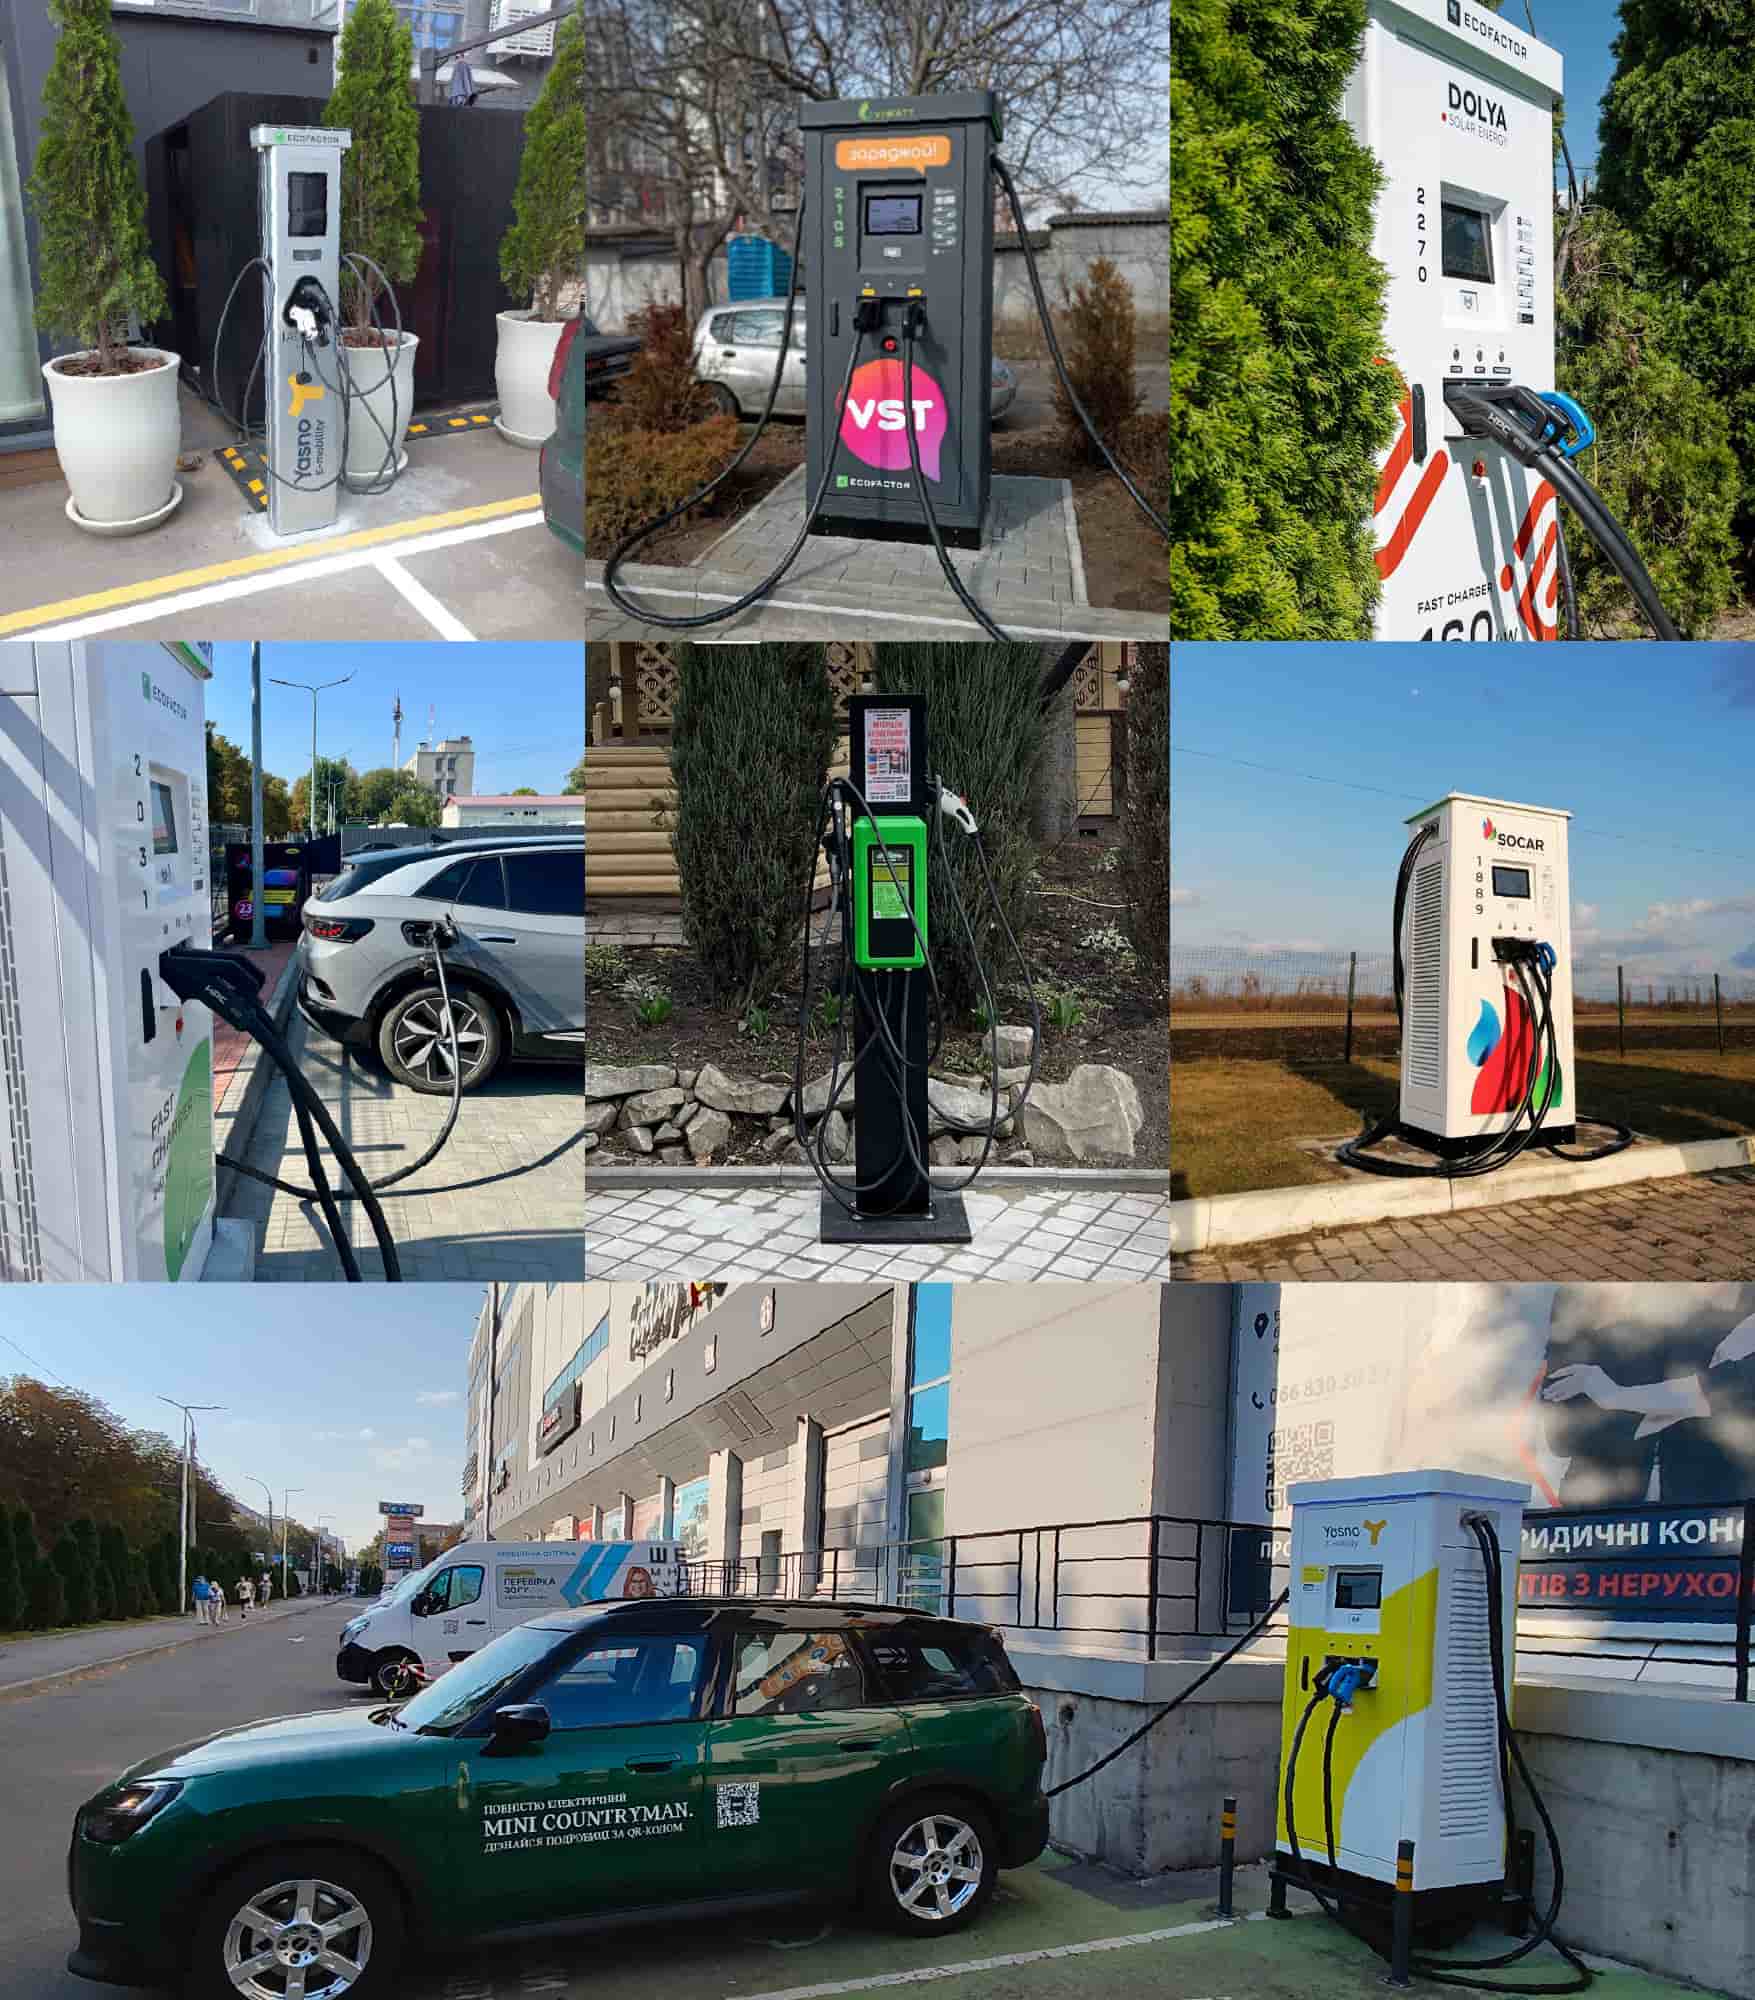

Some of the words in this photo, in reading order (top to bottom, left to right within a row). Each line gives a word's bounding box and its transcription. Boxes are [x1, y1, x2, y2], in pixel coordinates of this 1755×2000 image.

[1463, 12, 1528, 61] ECOFACTOR
[1448, 80, 1508, 132] DOLYA
[1448, 114, 1476, 134] SOLAR
[845, 398, 935, 432] VST
[294, 418, 313, 485] Yasno
[849, 478, 911, 489] ECOFACTOR
[1416, 595, 1444, 615] FAST
[1446, 582, 1494, 607] CHARGER
[1497, 832, 1545, 853] SOCAR
[151, 1091, 175, 1141] FAST
[1323, 1526, 1361, 1538] Yasno
[1599, 1572, 1741, 1598] НЕРУХО
[482, 1816, 538, 1838] MINI
[542, 1801, 694, 1832] COUNTRYMAN.
